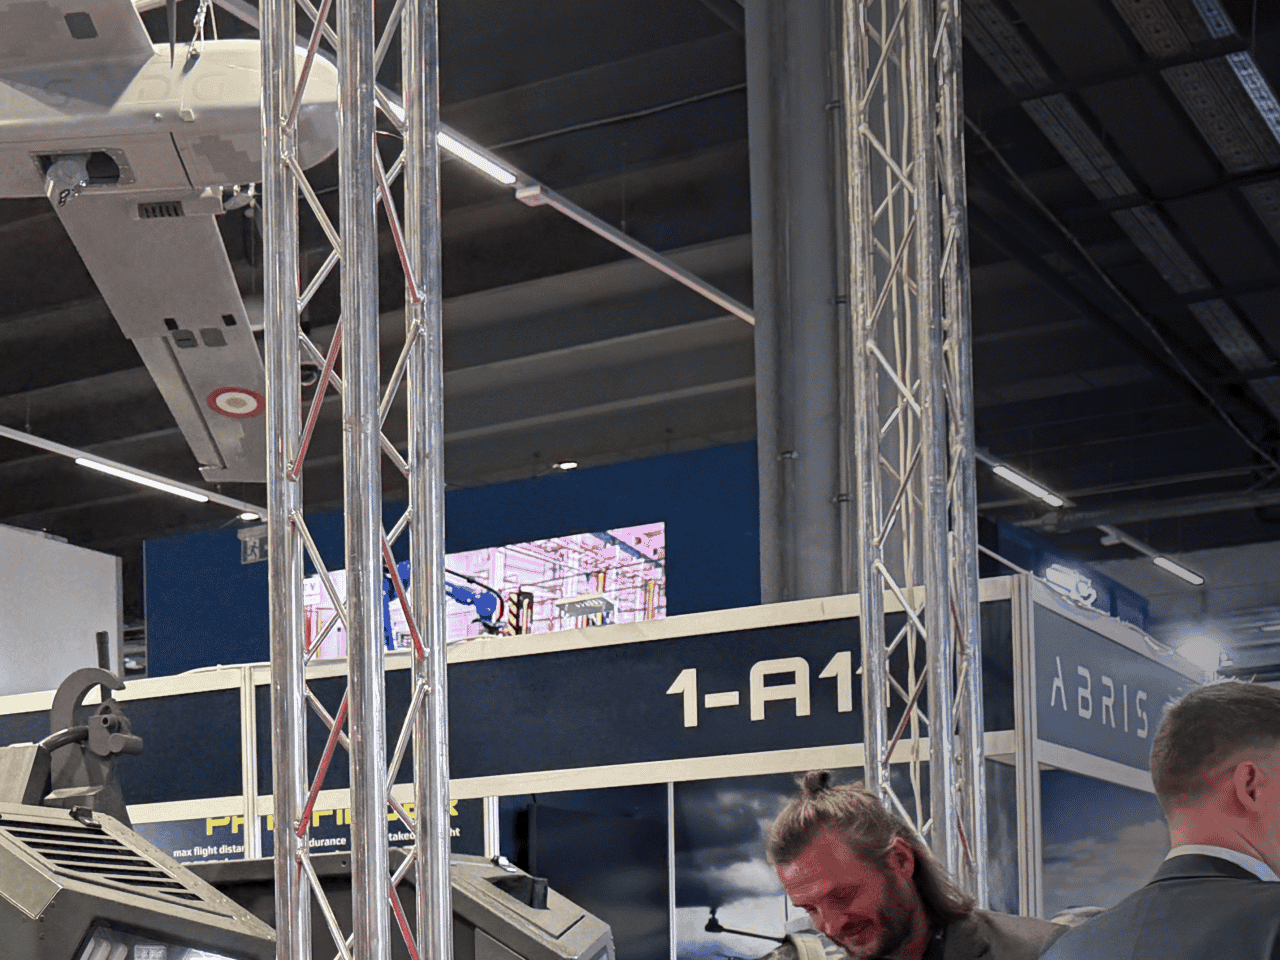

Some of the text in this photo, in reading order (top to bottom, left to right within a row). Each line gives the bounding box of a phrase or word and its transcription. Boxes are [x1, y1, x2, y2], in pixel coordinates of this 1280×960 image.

[666, 651, 891, 727] 1-A1
[1050, 655, 1149, 739] ABRIS
[173, 848, 192, 858] max
[193, 845, 218, 860] flight
